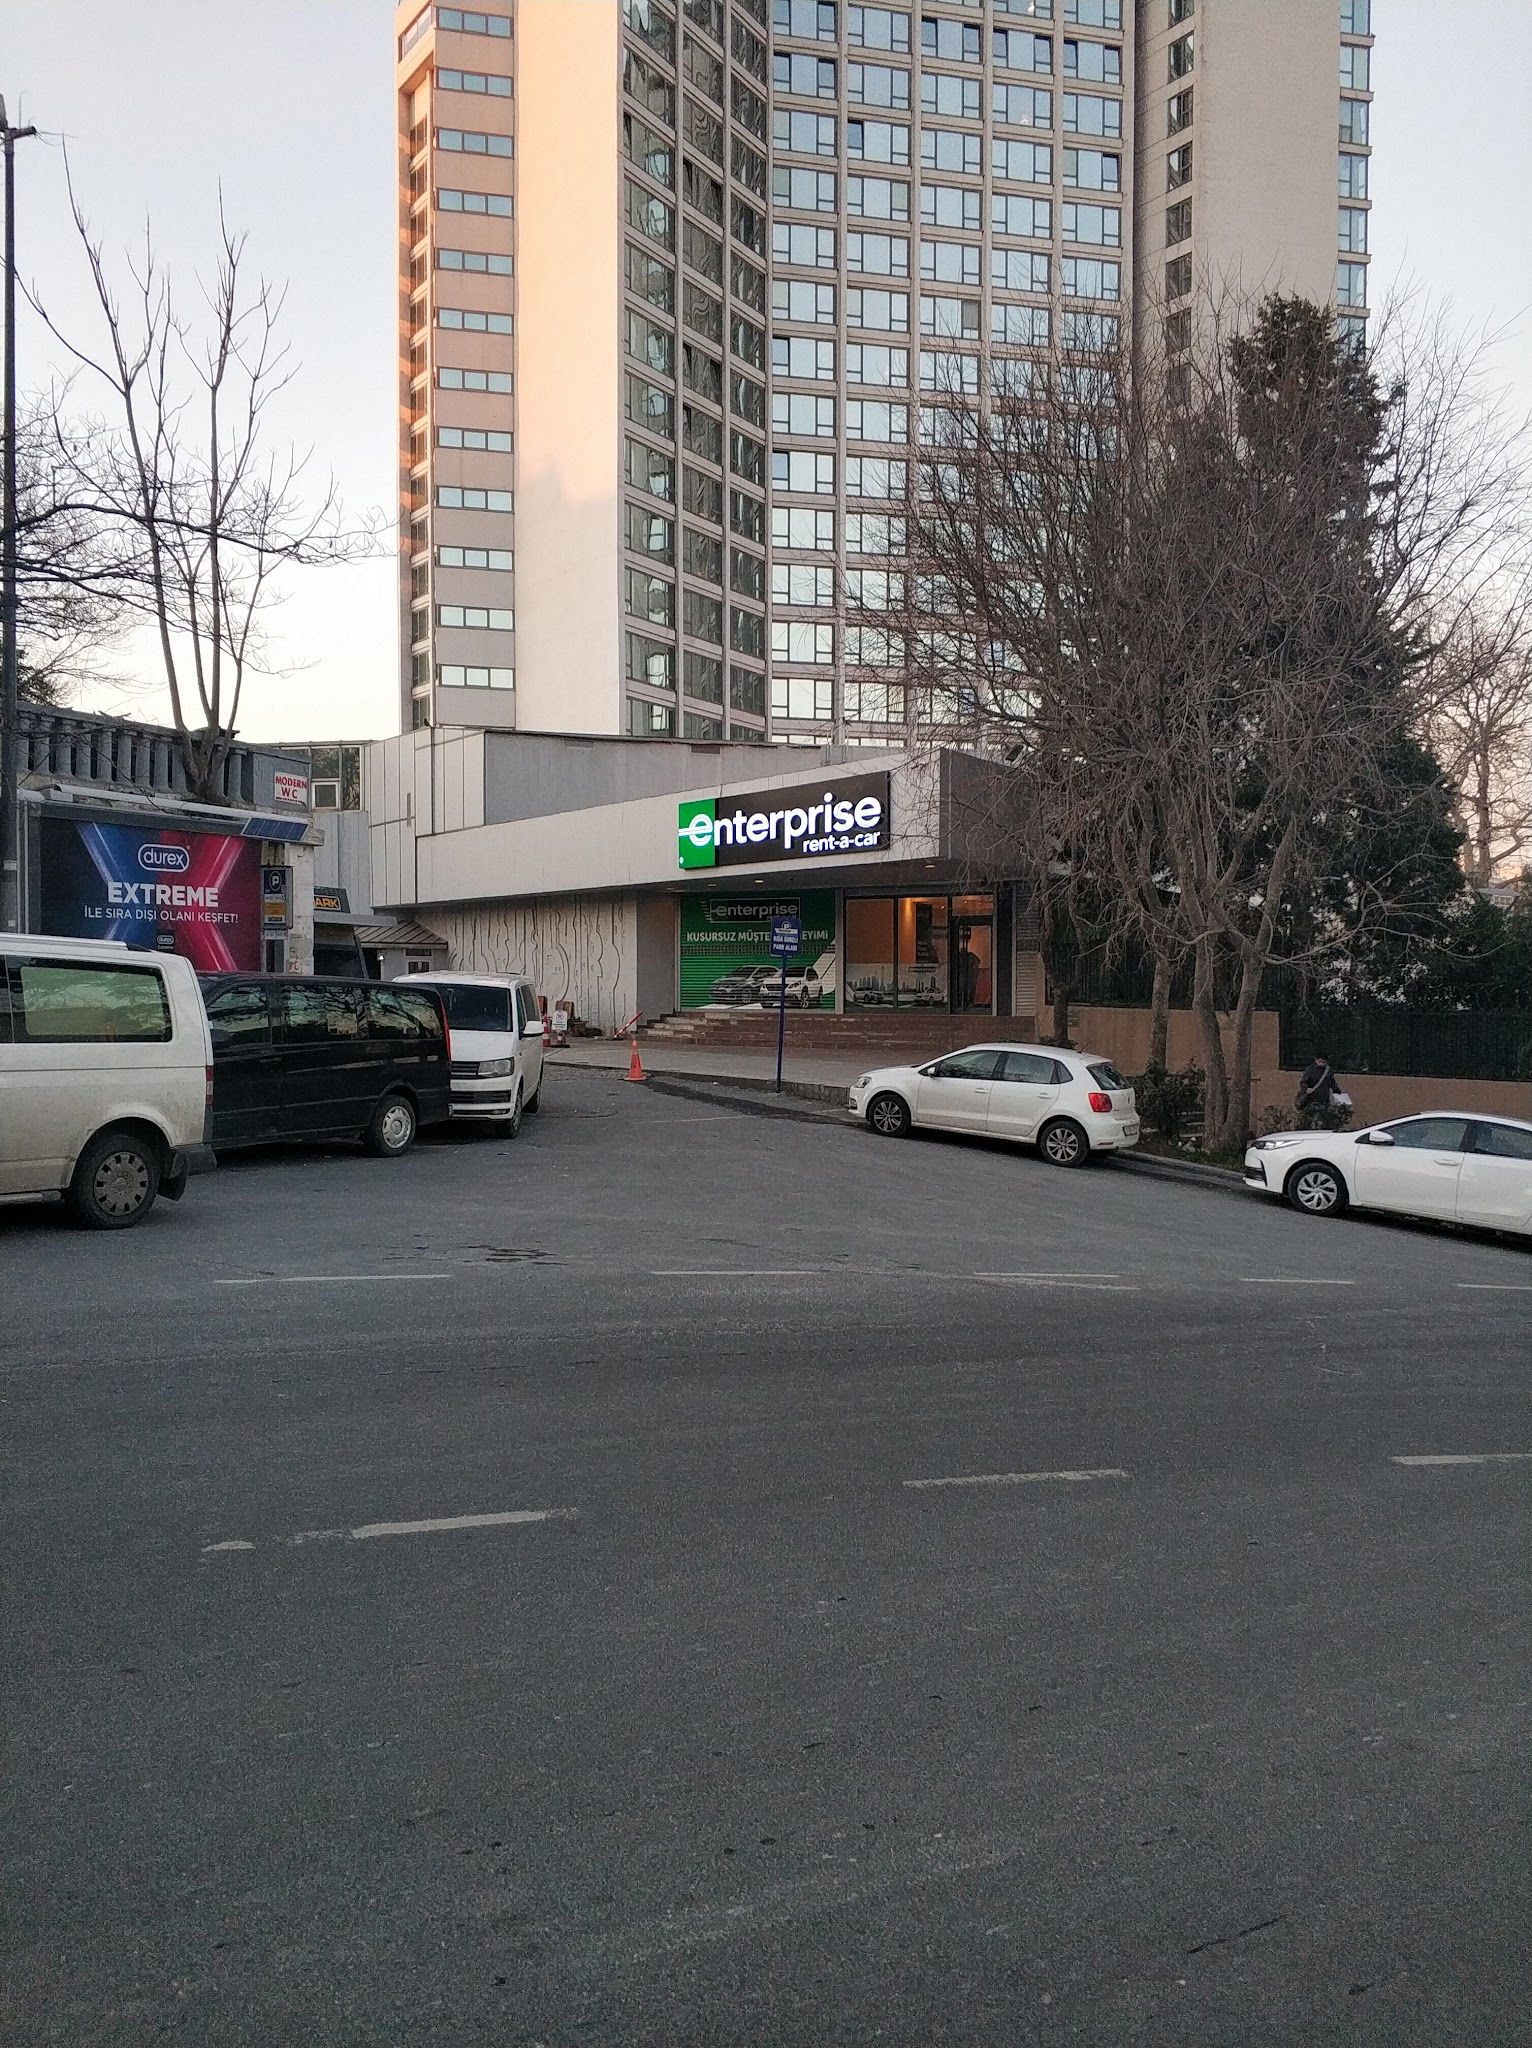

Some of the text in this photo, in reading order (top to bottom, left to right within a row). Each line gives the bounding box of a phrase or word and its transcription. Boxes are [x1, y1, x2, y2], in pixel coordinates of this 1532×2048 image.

[275, 776, 308, 790] MODERN
[281, 786, 298, 799] WC
[678, 792, 882, 849] enterprise
[803, 831, 881, 853] rent-a-car
[143, 847, 186, 870] durex
[107, 881, 219, 908] EXTREME
[314, 897, 339, 908] ARK
[84, 904, 239, 924] İLE SIRA DIŞI OLANI KEŞFET!
[711, 902, 798, 919] enterprise
[686, 931, 737, 942] KUSURSUZ
[738, 929, 770, 943] MÜŞTE
